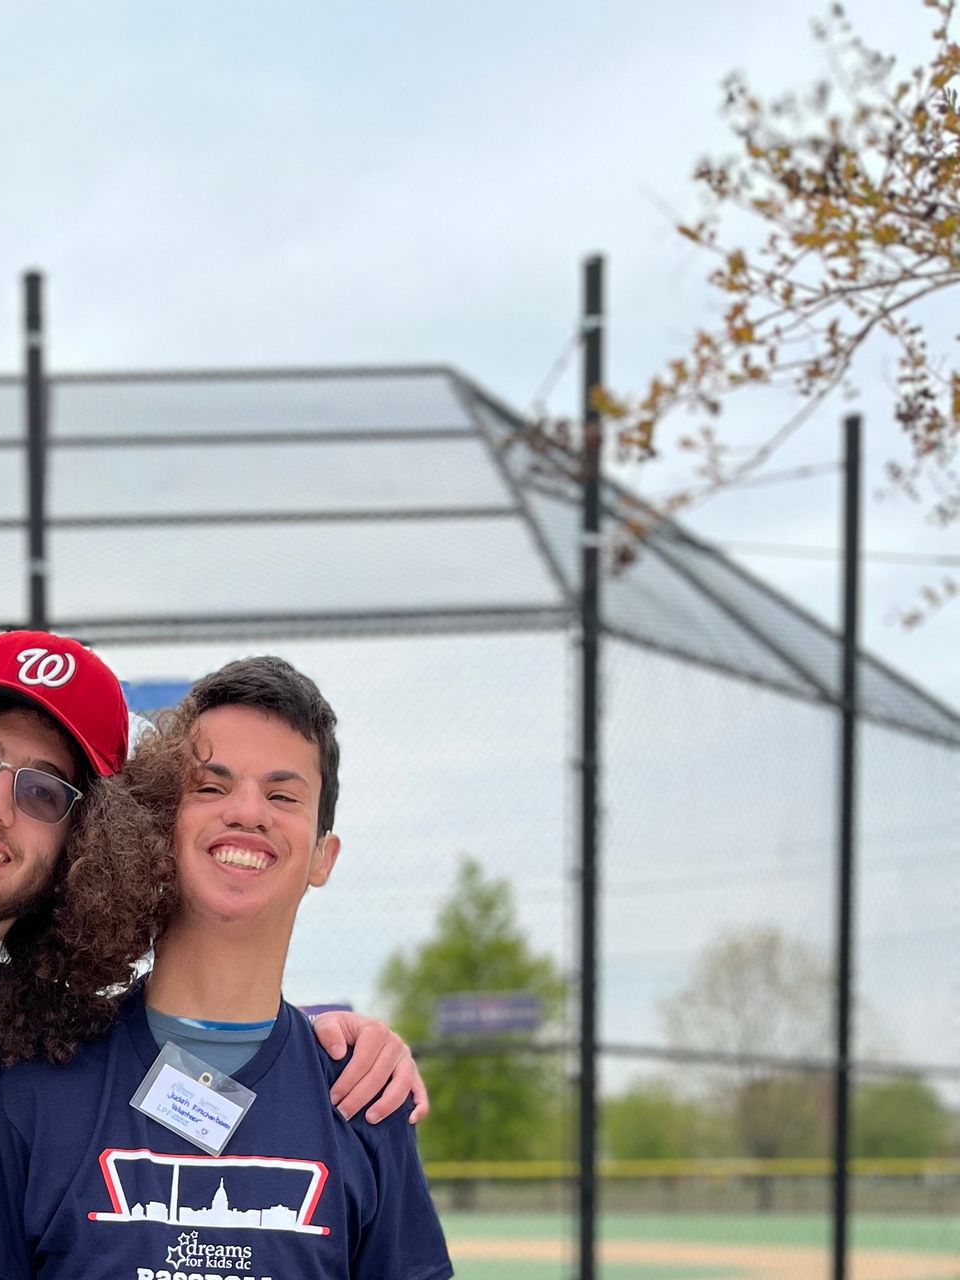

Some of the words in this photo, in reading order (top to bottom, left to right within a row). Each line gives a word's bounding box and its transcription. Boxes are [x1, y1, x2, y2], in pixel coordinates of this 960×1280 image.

[16, 648, 76, 687] W
[185, 1239, 252, 1258] dreams
[185, 1255, 203, 1267] for
[206, 1256, 232, 1269] kids
[235, 1257, 252, 1269] dc
